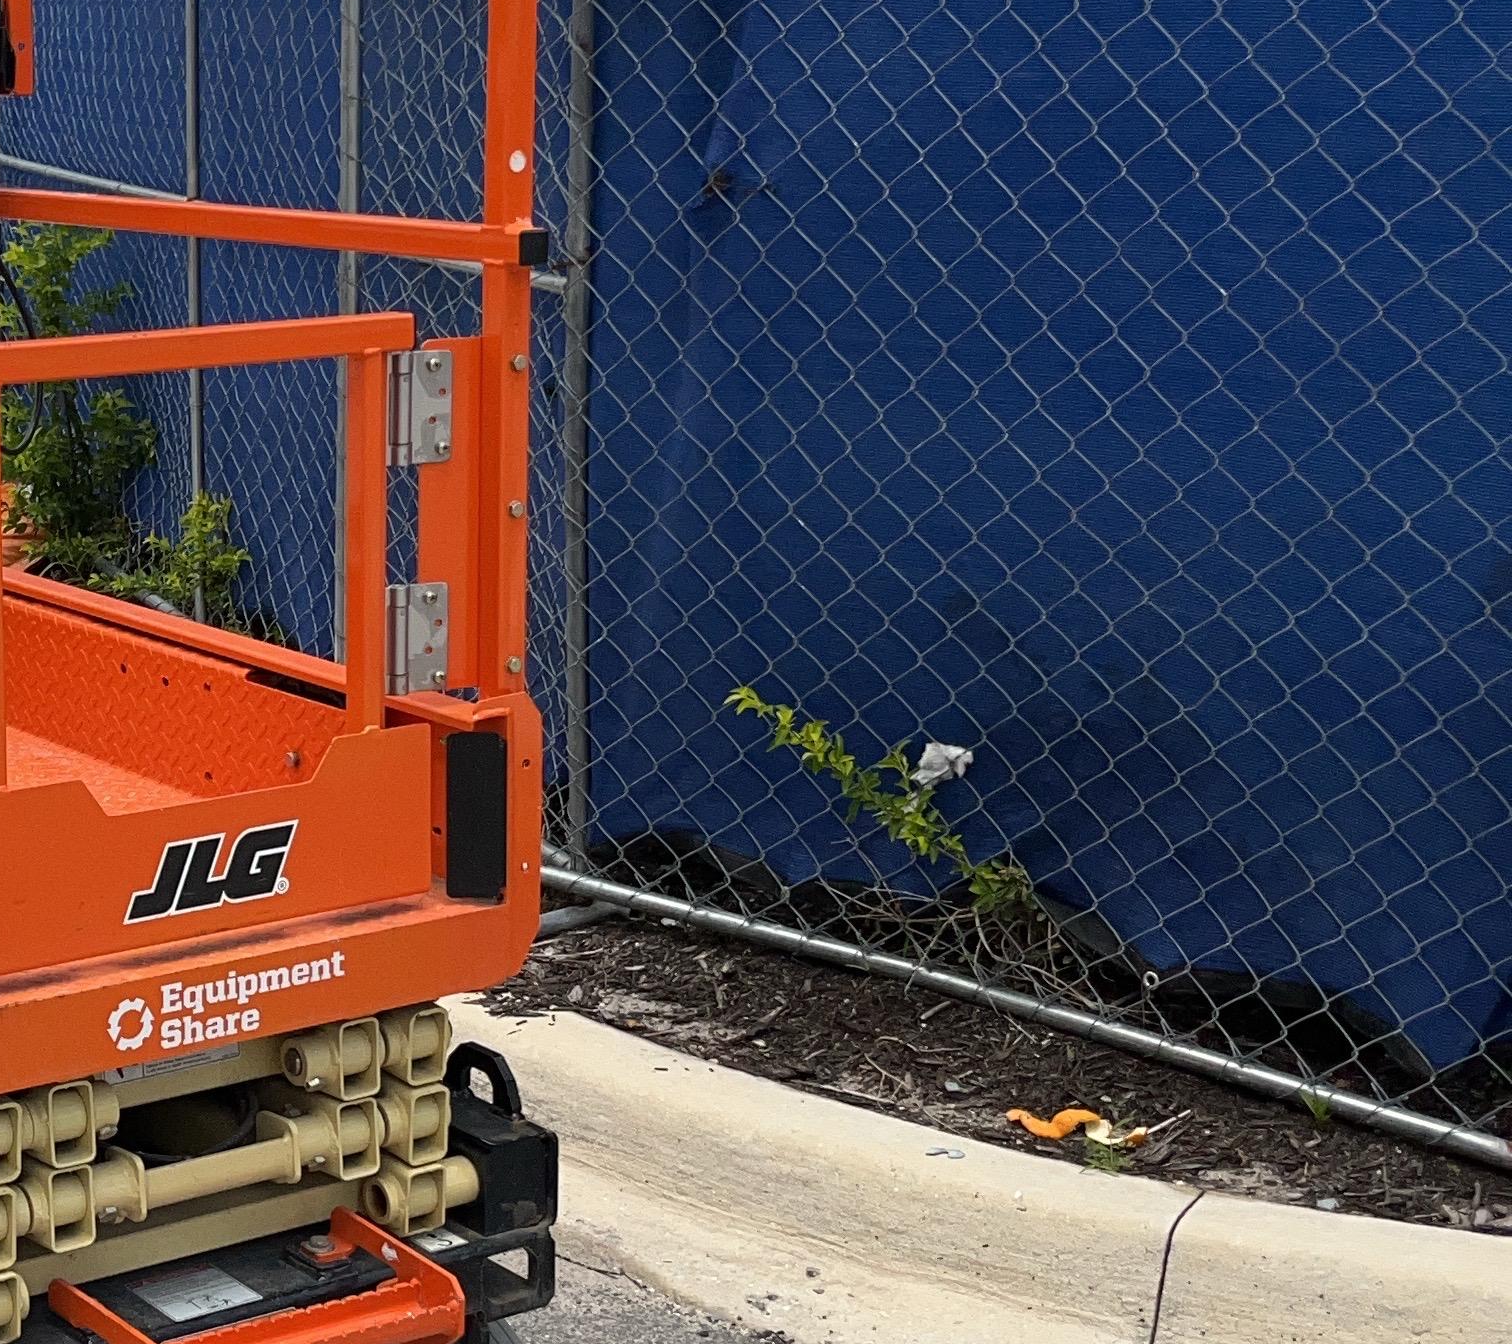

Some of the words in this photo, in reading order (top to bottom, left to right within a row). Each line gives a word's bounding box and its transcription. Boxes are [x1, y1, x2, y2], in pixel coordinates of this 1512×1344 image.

[123, 819, 300, 925] JLG
[160, 950, 345, 1015] Equipment
[160, 1008, 261, 1050] Share
